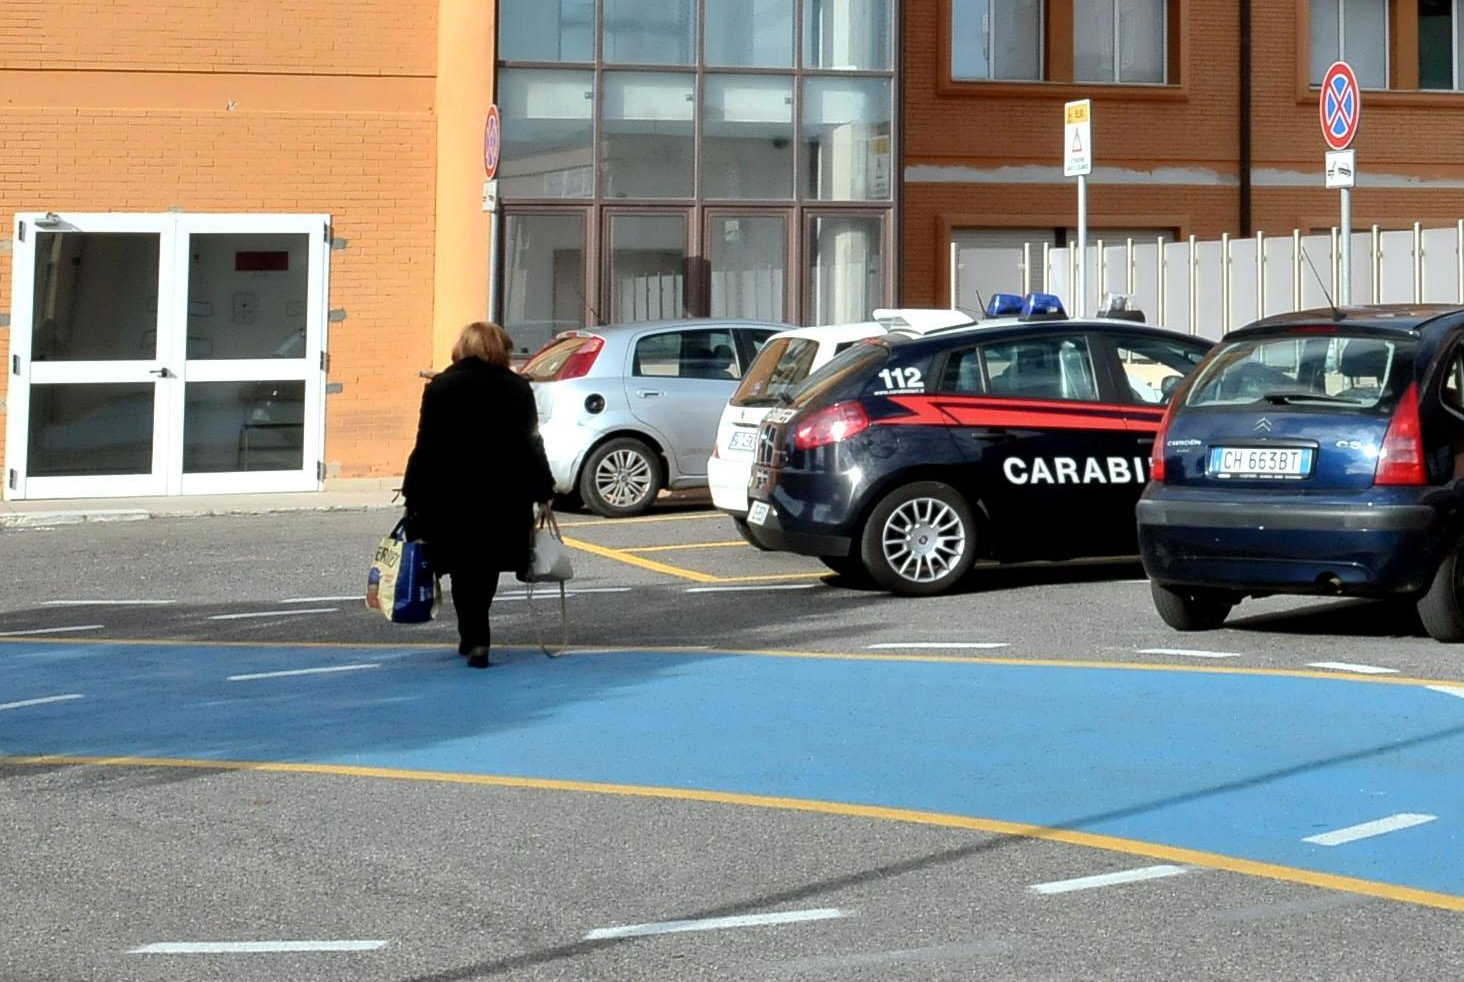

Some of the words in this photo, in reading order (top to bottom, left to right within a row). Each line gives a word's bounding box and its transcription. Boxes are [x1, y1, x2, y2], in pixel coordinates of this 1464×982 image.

[878, 366, 925, 389] 112
[1003, 456, 1155, 485] CARABI
[1224, 451, 1243, 470] CH
[1248, 451, 1299, 471] 663BT
